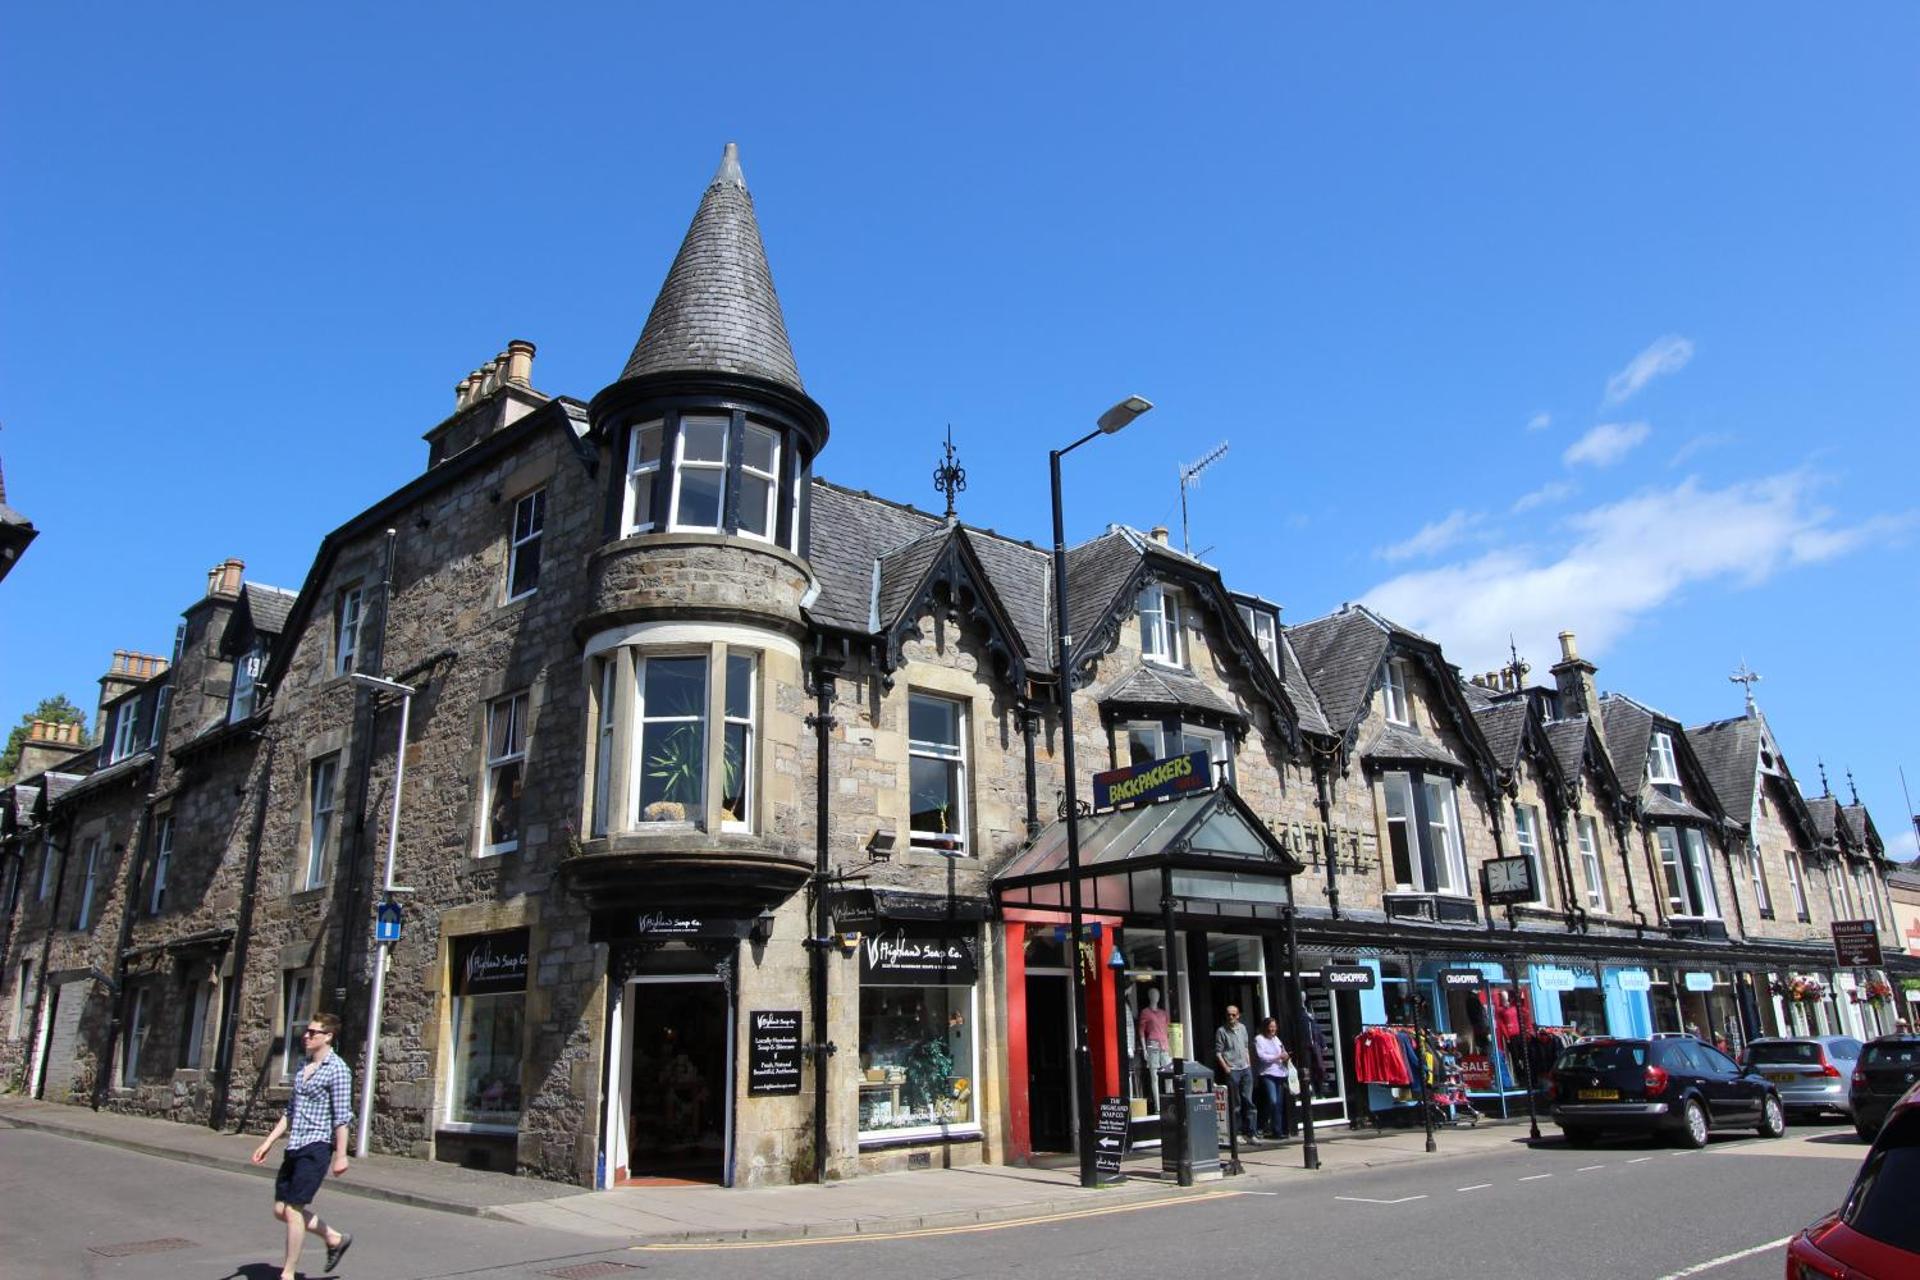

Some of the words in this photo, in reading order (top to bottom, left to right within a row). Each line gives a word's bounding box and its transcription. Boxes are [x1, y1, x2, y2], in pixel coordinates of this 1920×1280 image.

[1109, 756, 1192, 804] BACKPACKERS
[1835, 924, 1862, 932] Hotels
[880, 927, 921, 964] Highland
[922, 945, 946, 963] Soap
[948, 946, 963, 959] Co.
[502, 954, 518, 971] Soap
[1330, 972, 1368, 983] CRAGHOPPERS
[1446, 974, 1478, 984] CRAGHOPPERS
[1461, 1061, 1490, 1072] SALE
[1193, 1104, 1212, 1112] LITTER
